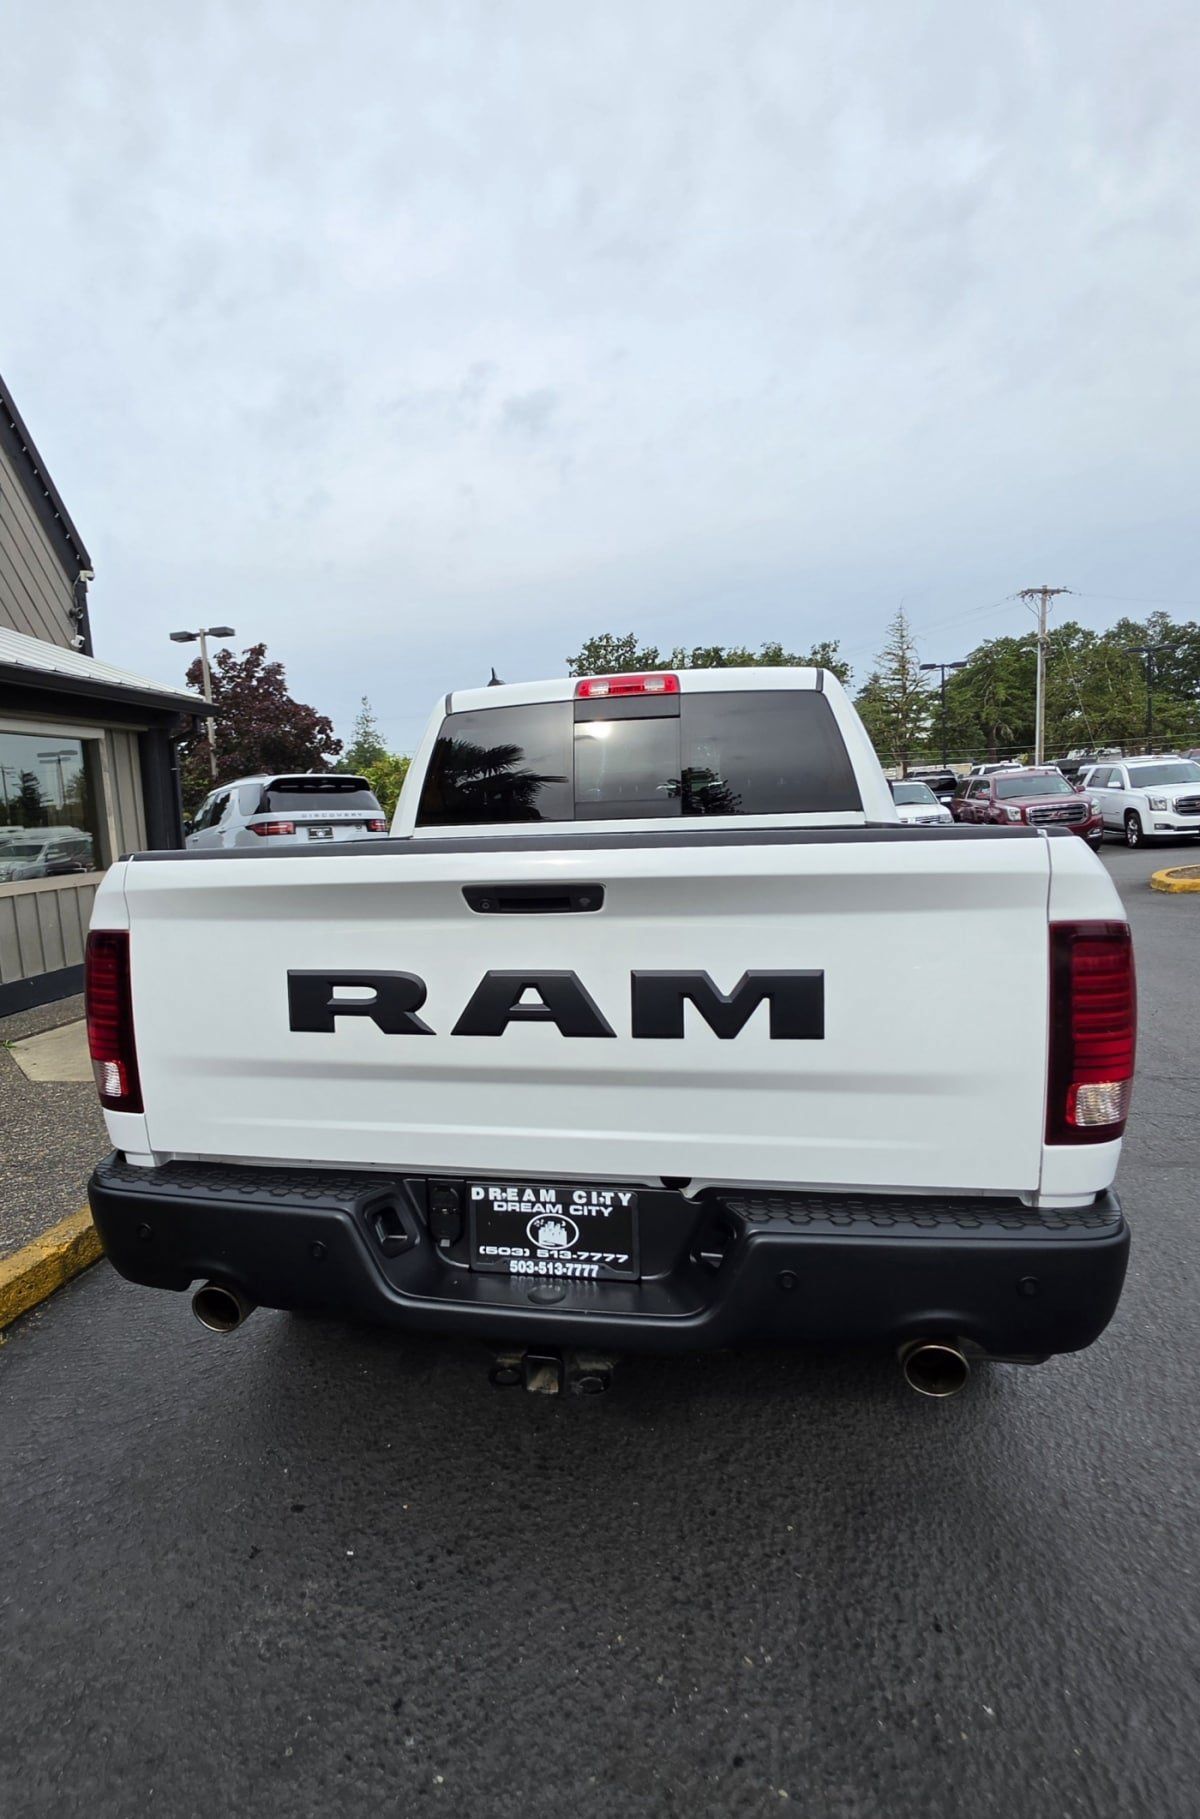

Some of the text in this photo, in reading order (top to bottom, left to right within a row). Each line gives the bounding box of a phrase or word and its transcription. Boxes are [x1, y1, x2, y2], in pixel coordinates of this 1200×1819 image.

[287, 970, 824, 1040] RAM
[471, 1187, 632, 1206] DREAM CITY
[493, 1201, 613, 1217] DREAM CITY
[479, 1246, 629, 1263] (503) 513-7777
[509, 1260, 599, 1278] 503-513-7777
